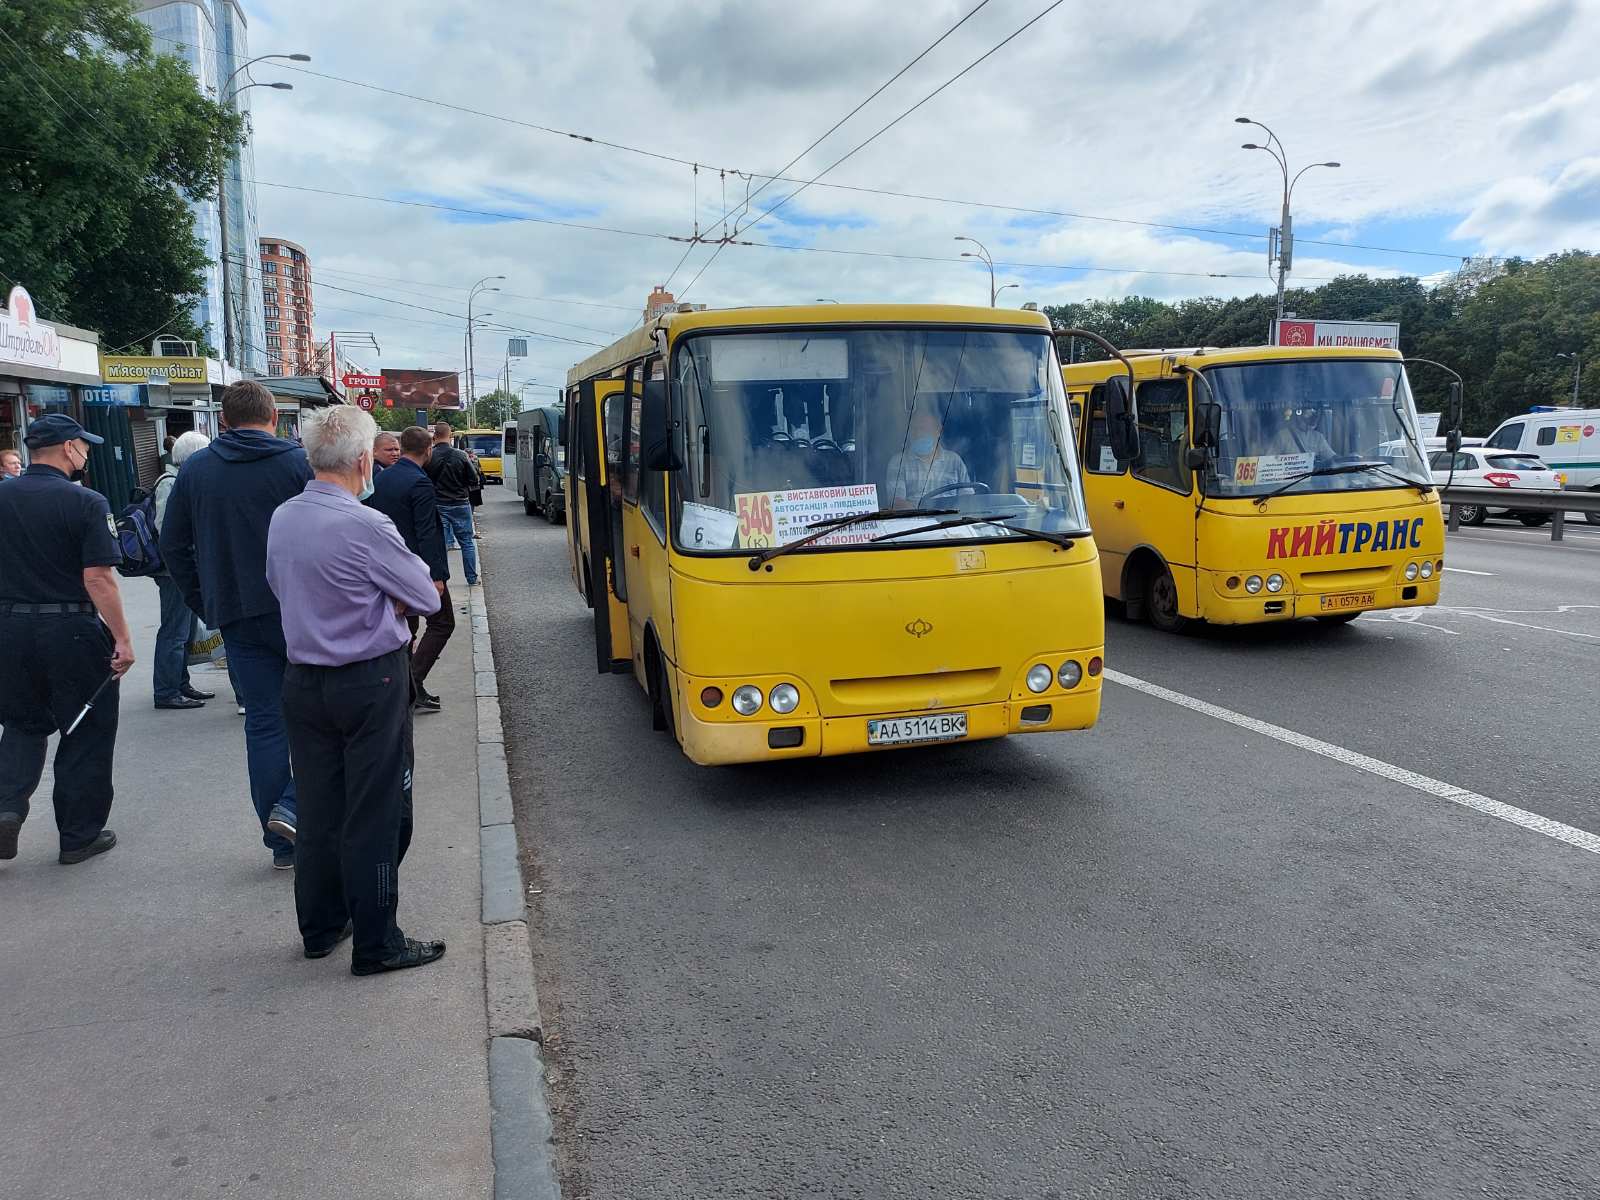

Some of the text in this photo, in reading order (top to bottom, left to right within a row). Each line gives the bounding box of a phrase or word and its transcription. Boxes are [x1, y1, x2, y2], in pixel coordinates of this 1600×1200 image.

[348, 377, 381, 386] ГРОШІ
[1237, 462, 1257, 480] 365
[848, 486, 875, 497] ЦЕНТР
[738, 495, 773, 536] 546
[774, 502, 828, 513] АВТОСТАНЦІЯ
[694, 526, 705, 544] 6
[1266, 517, 1424, 560] КИЙТРАНС
[1340, 595, 1360, 607] 0579
[905, 719, 938, 736] 5114
